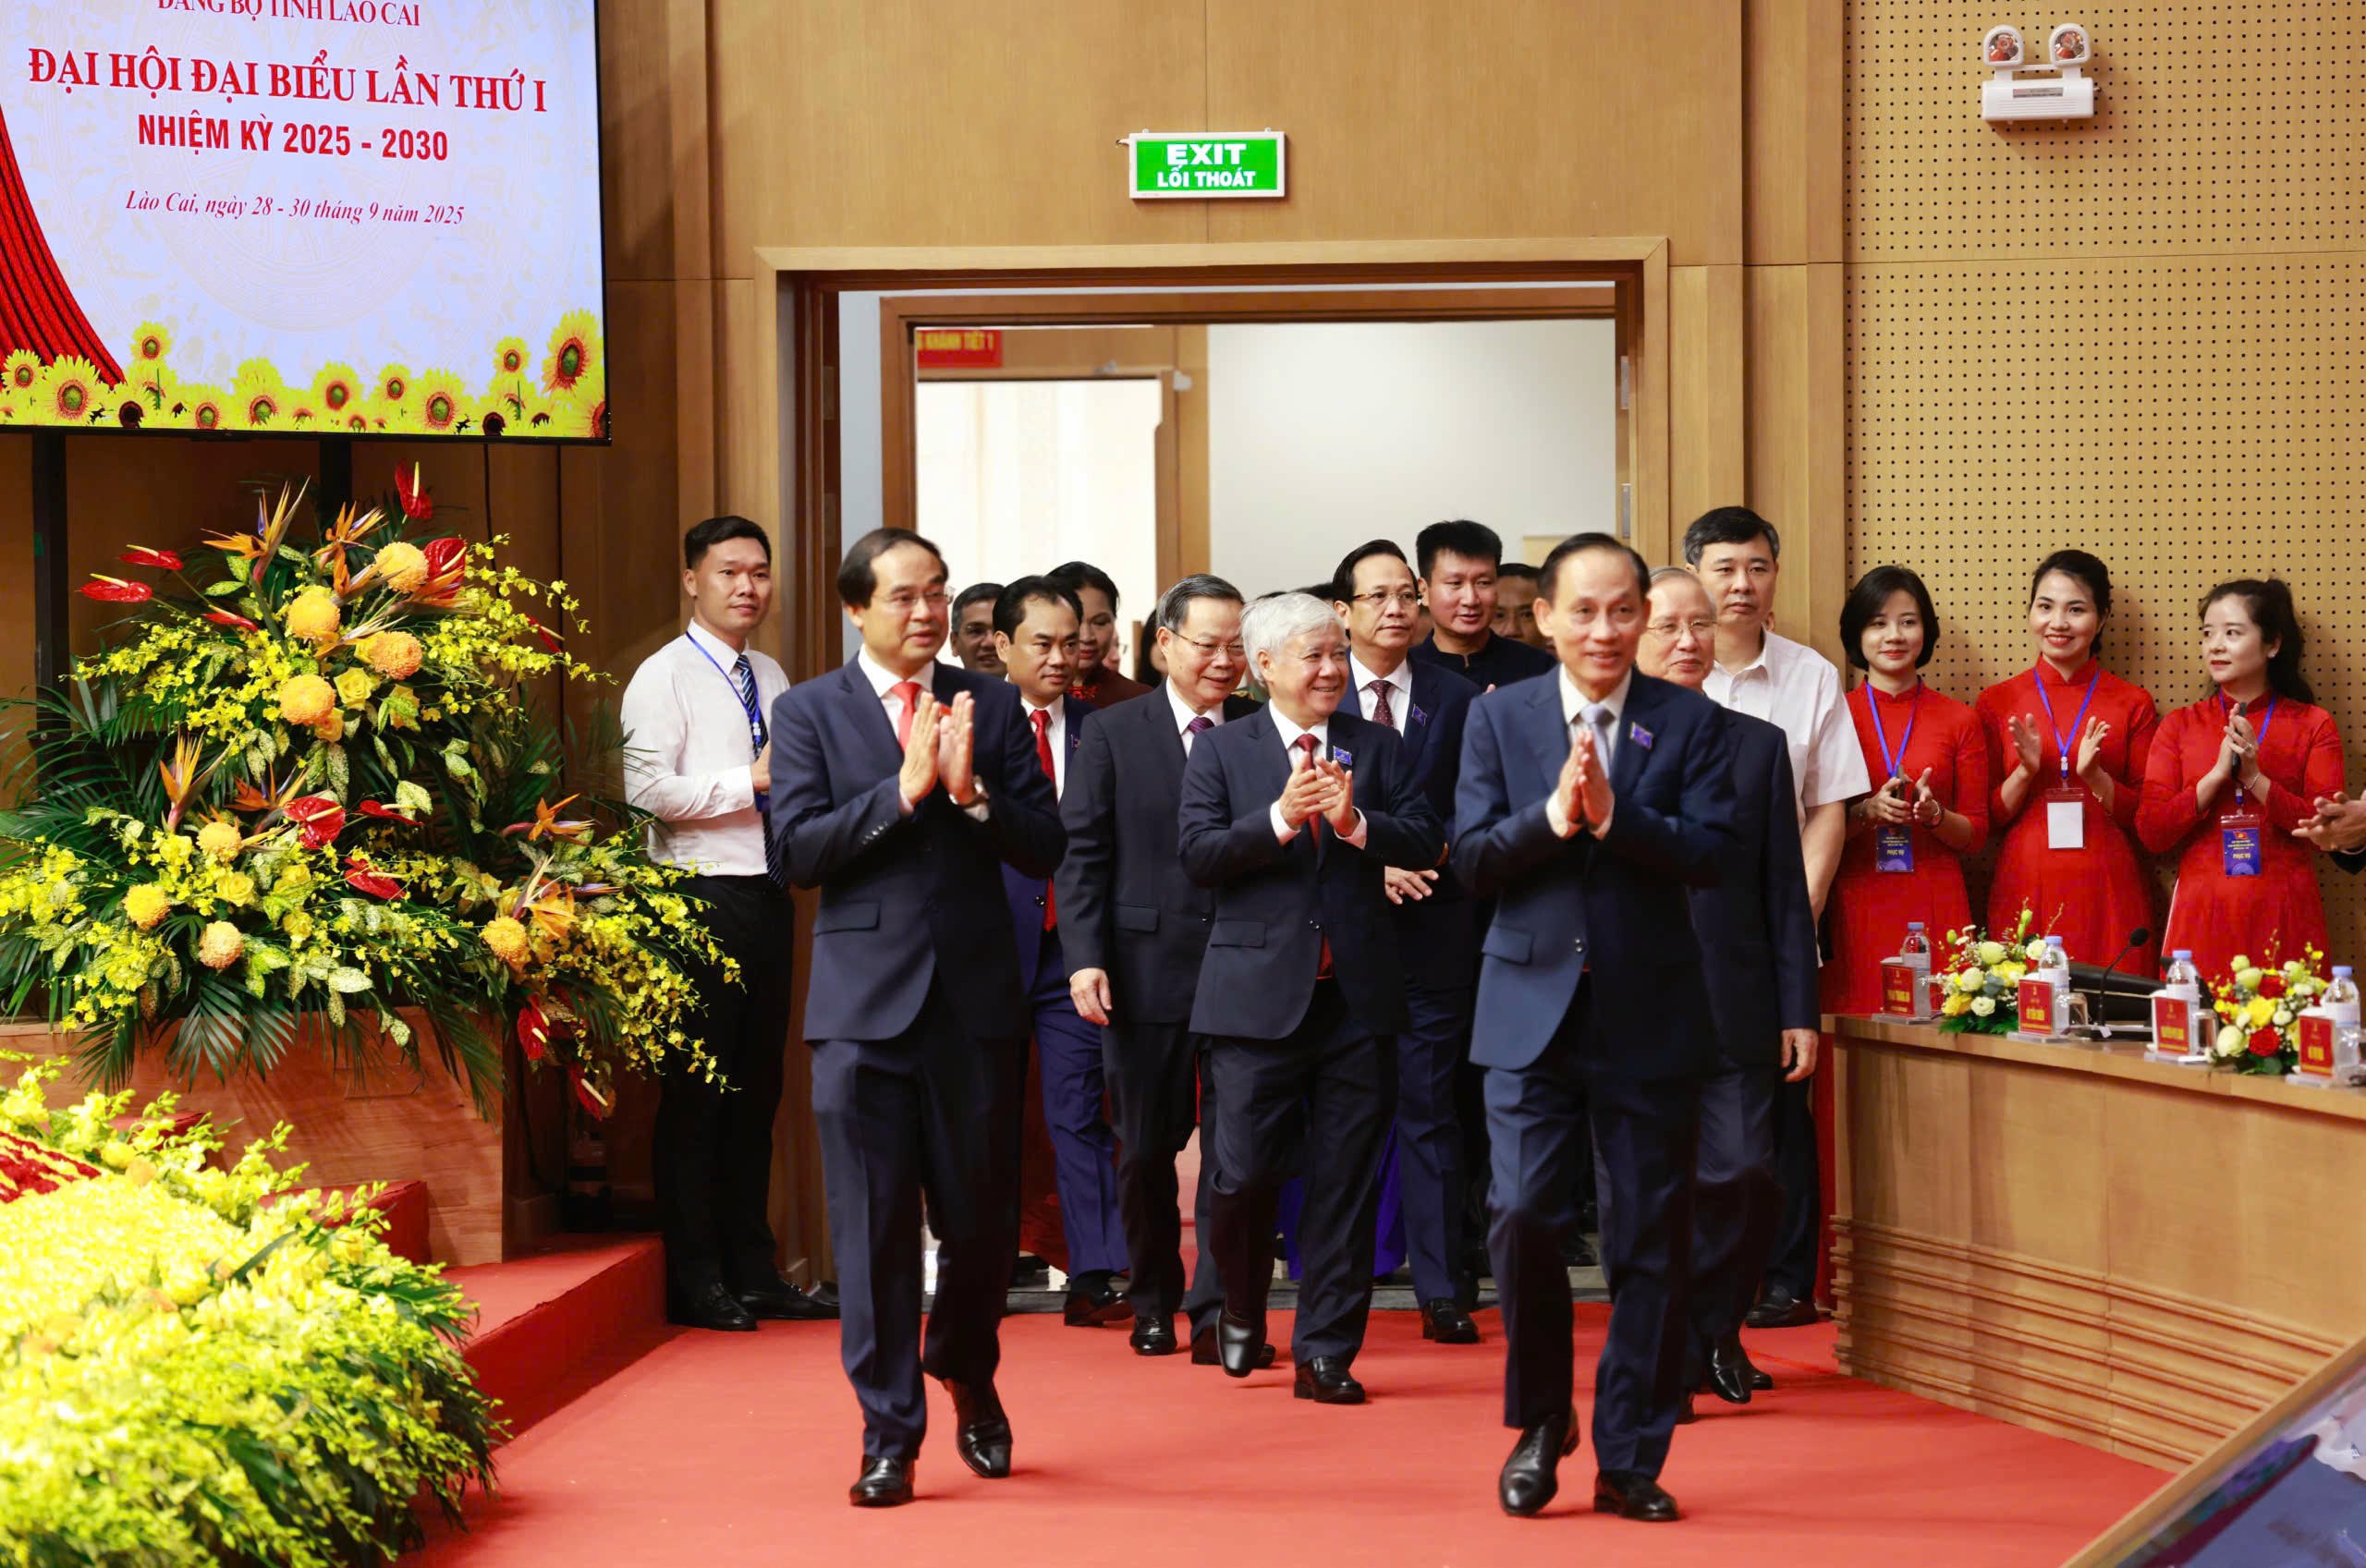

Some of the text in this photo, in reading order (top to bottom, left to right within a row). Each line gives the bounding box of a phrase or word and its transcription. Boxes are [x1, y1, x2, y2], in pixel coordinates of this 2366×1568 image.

[381, 2, 421, 27] CAI
[29, 44, 547, 113] ĐẠI HỘI ĐẠI BIỂU LẦN THỨ I
[138, 108, 448, 162] NHIỆM KỲ 2025 - 2030
[1166, 143, 1247, 166] EXIT
[1157, 164, 1256, 188] LỐI THOÁT
[126, 189, 160, 211] Lào
[165, 191, 200, 214] Cai,
[205, 195, 248, 220] ngày
[250, 196, 274, 216] 28
[288, 198, 311, 217] 30
[313, 199, 363, 225] tháng
[369, 201, 379, 220] 9
[382, 204, 419, 223] năm
[423, 204, 465, 225] 2025
